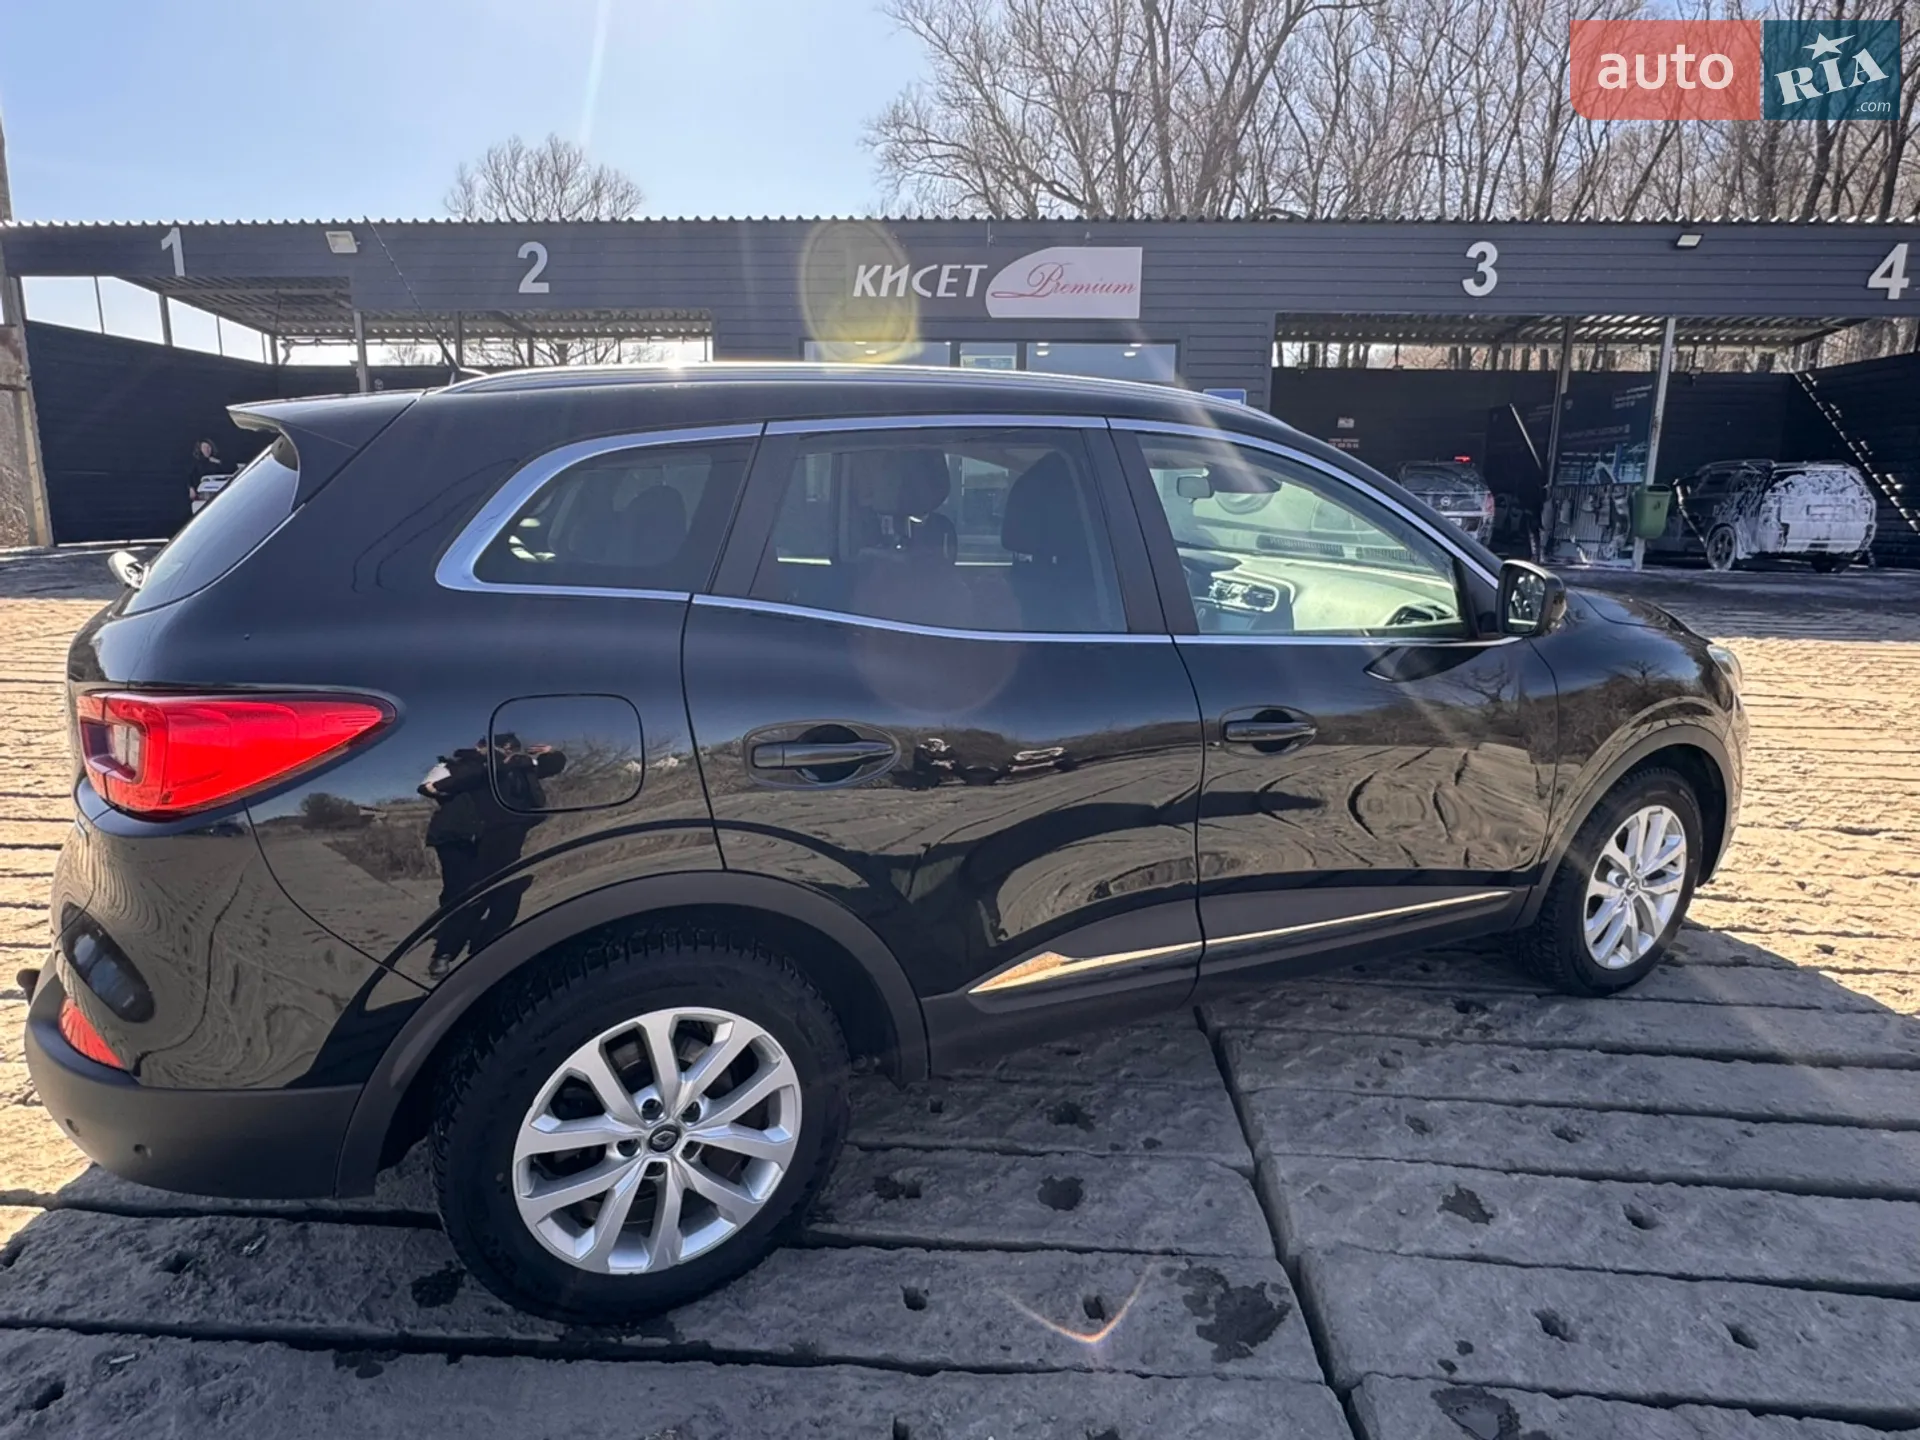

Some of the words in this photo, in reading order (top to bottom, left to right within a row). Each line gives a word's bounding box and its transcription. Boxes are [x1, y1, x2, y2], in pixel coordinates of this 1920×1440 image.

[160, 227, 185, 277] 1
[517, 241, 550, 294] 2
[1461, 241, 1498, 297] 3
[1867, 243, 1910, 300] 4
[853, 264, 988, 298] КИСЕТ
[991, 261, 1136, 298] Premium
